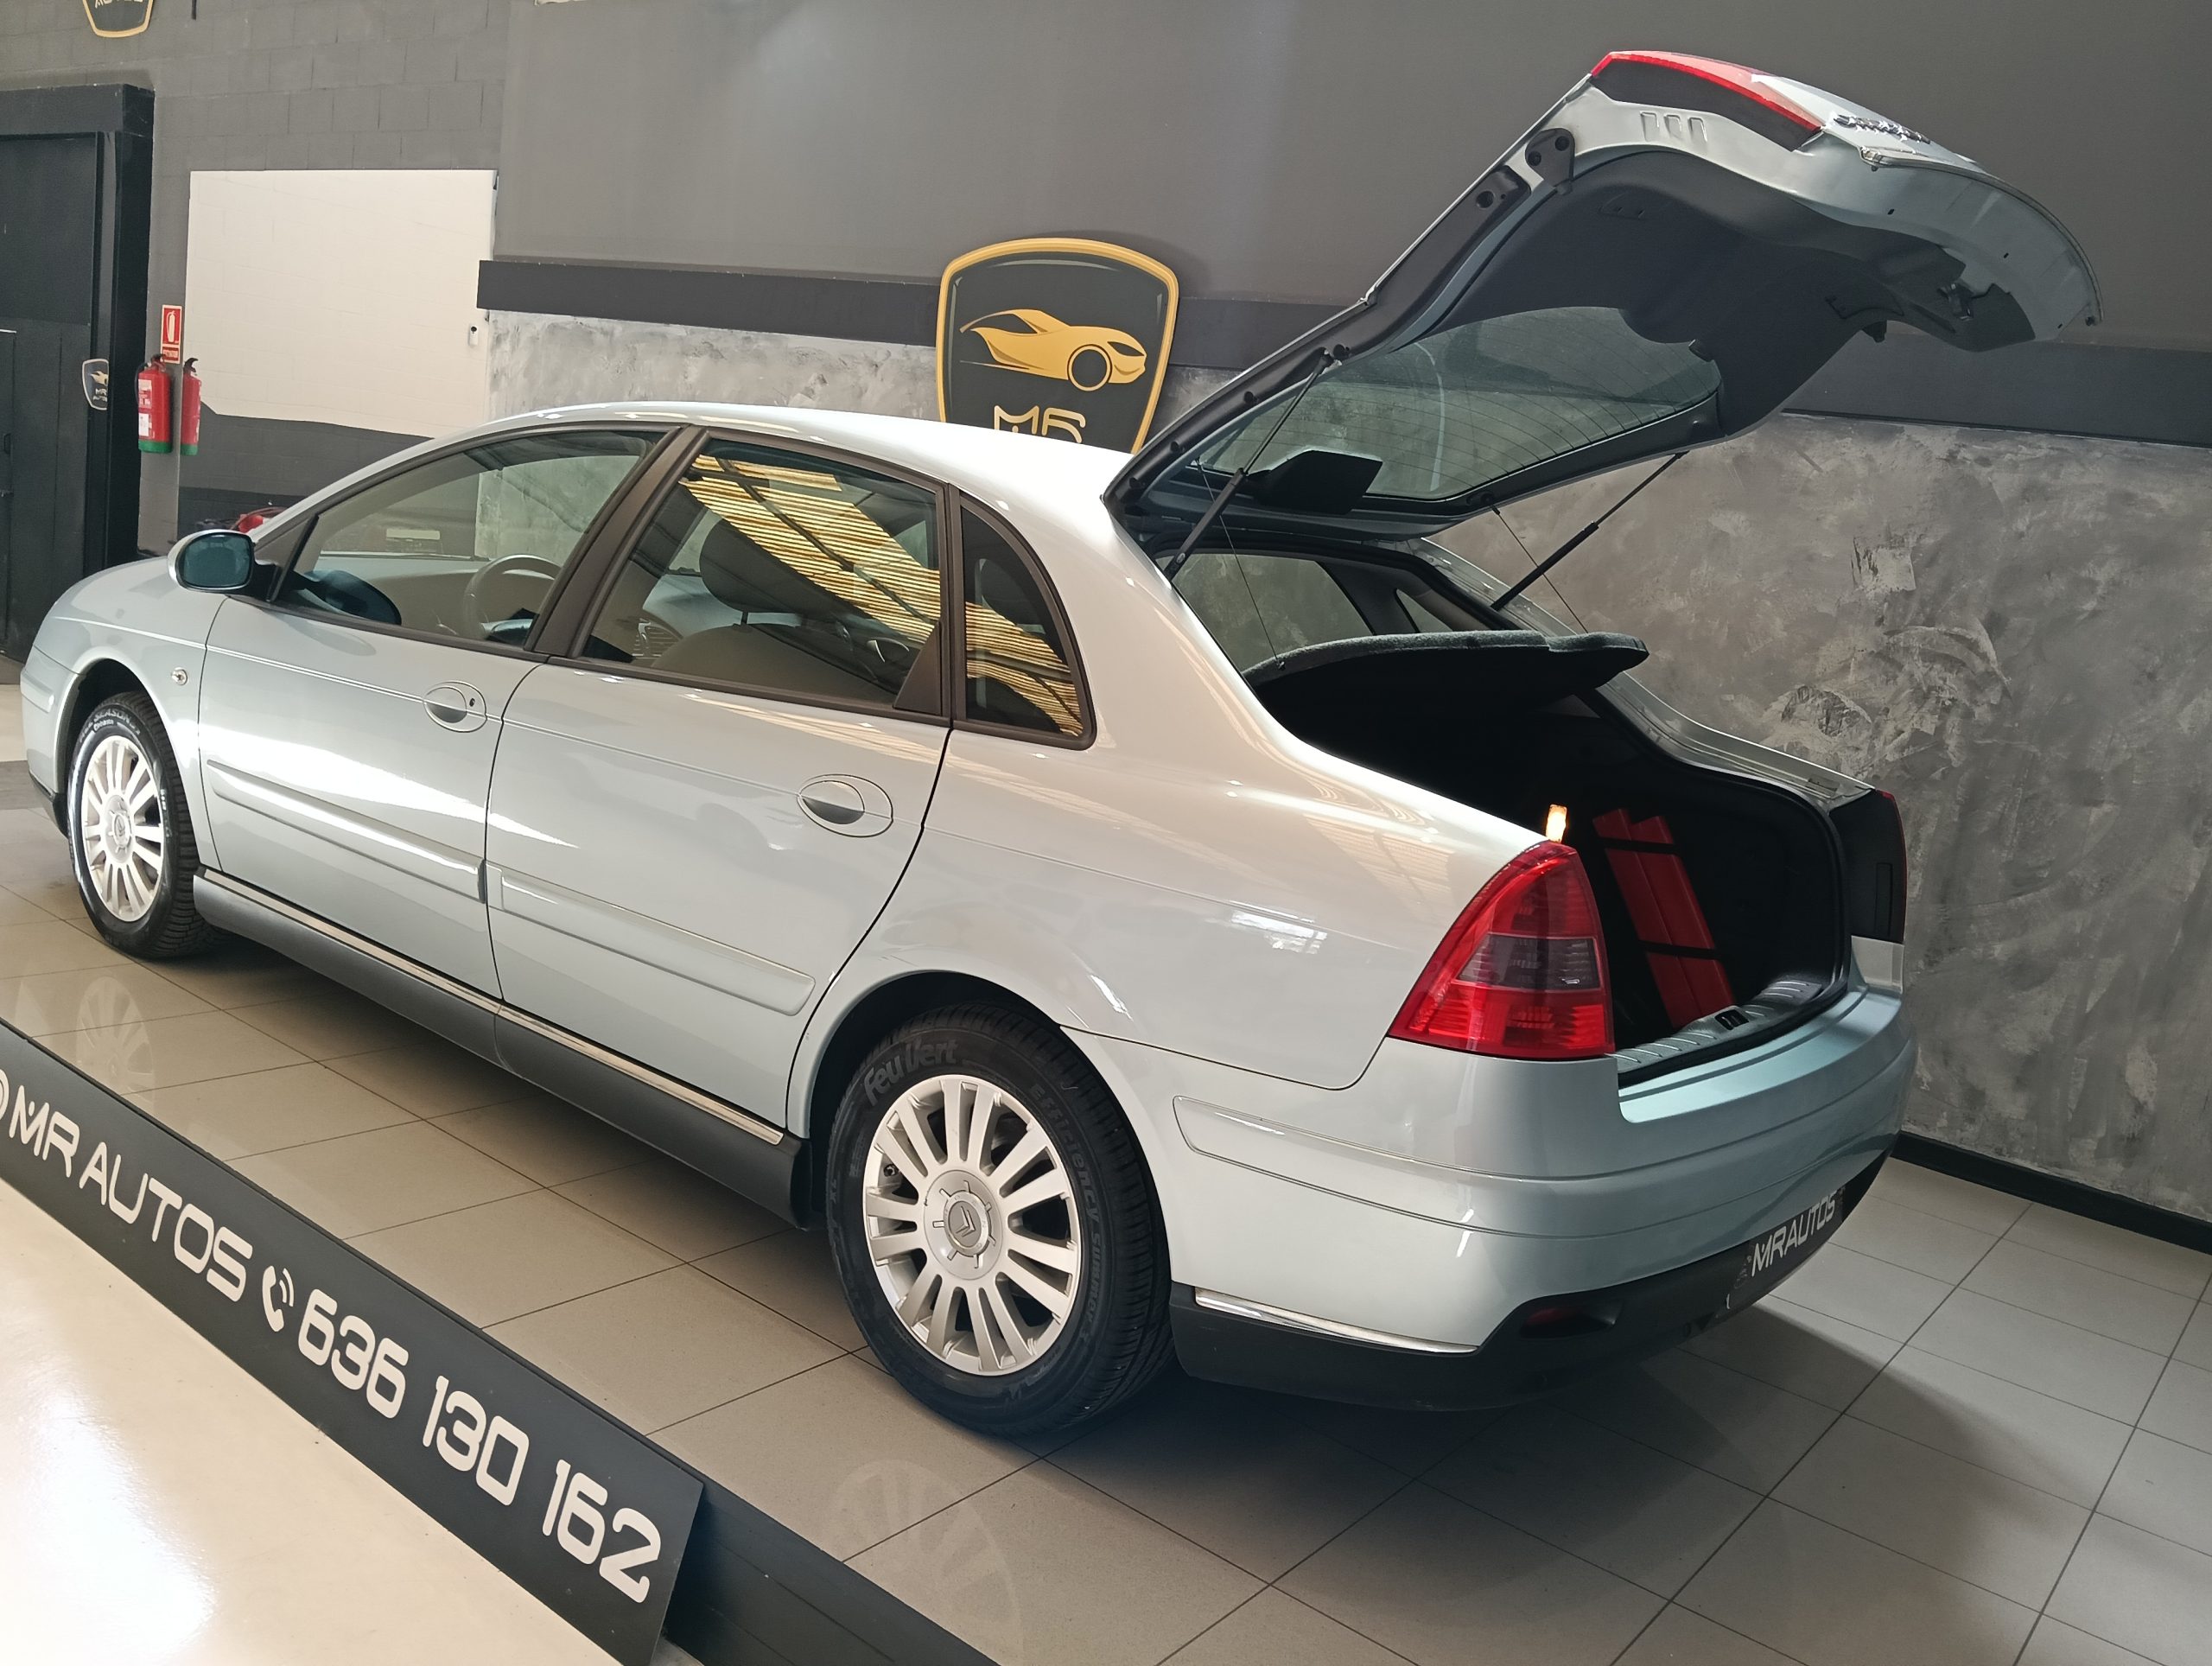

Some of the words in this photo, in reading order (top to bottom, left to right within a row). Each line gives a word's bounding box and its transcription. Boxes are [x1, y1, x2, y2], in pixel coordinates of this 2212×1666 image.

[994, 404, 1086, 443] MR
[9, 1084, 79, 1178] MR
[79, 1141, 253, 1302] AUTOS
[298, 1288, 409, 1419] 636
[423, 1375, 530, 1505] 130
[542, 1459, 662, 1603] 162
